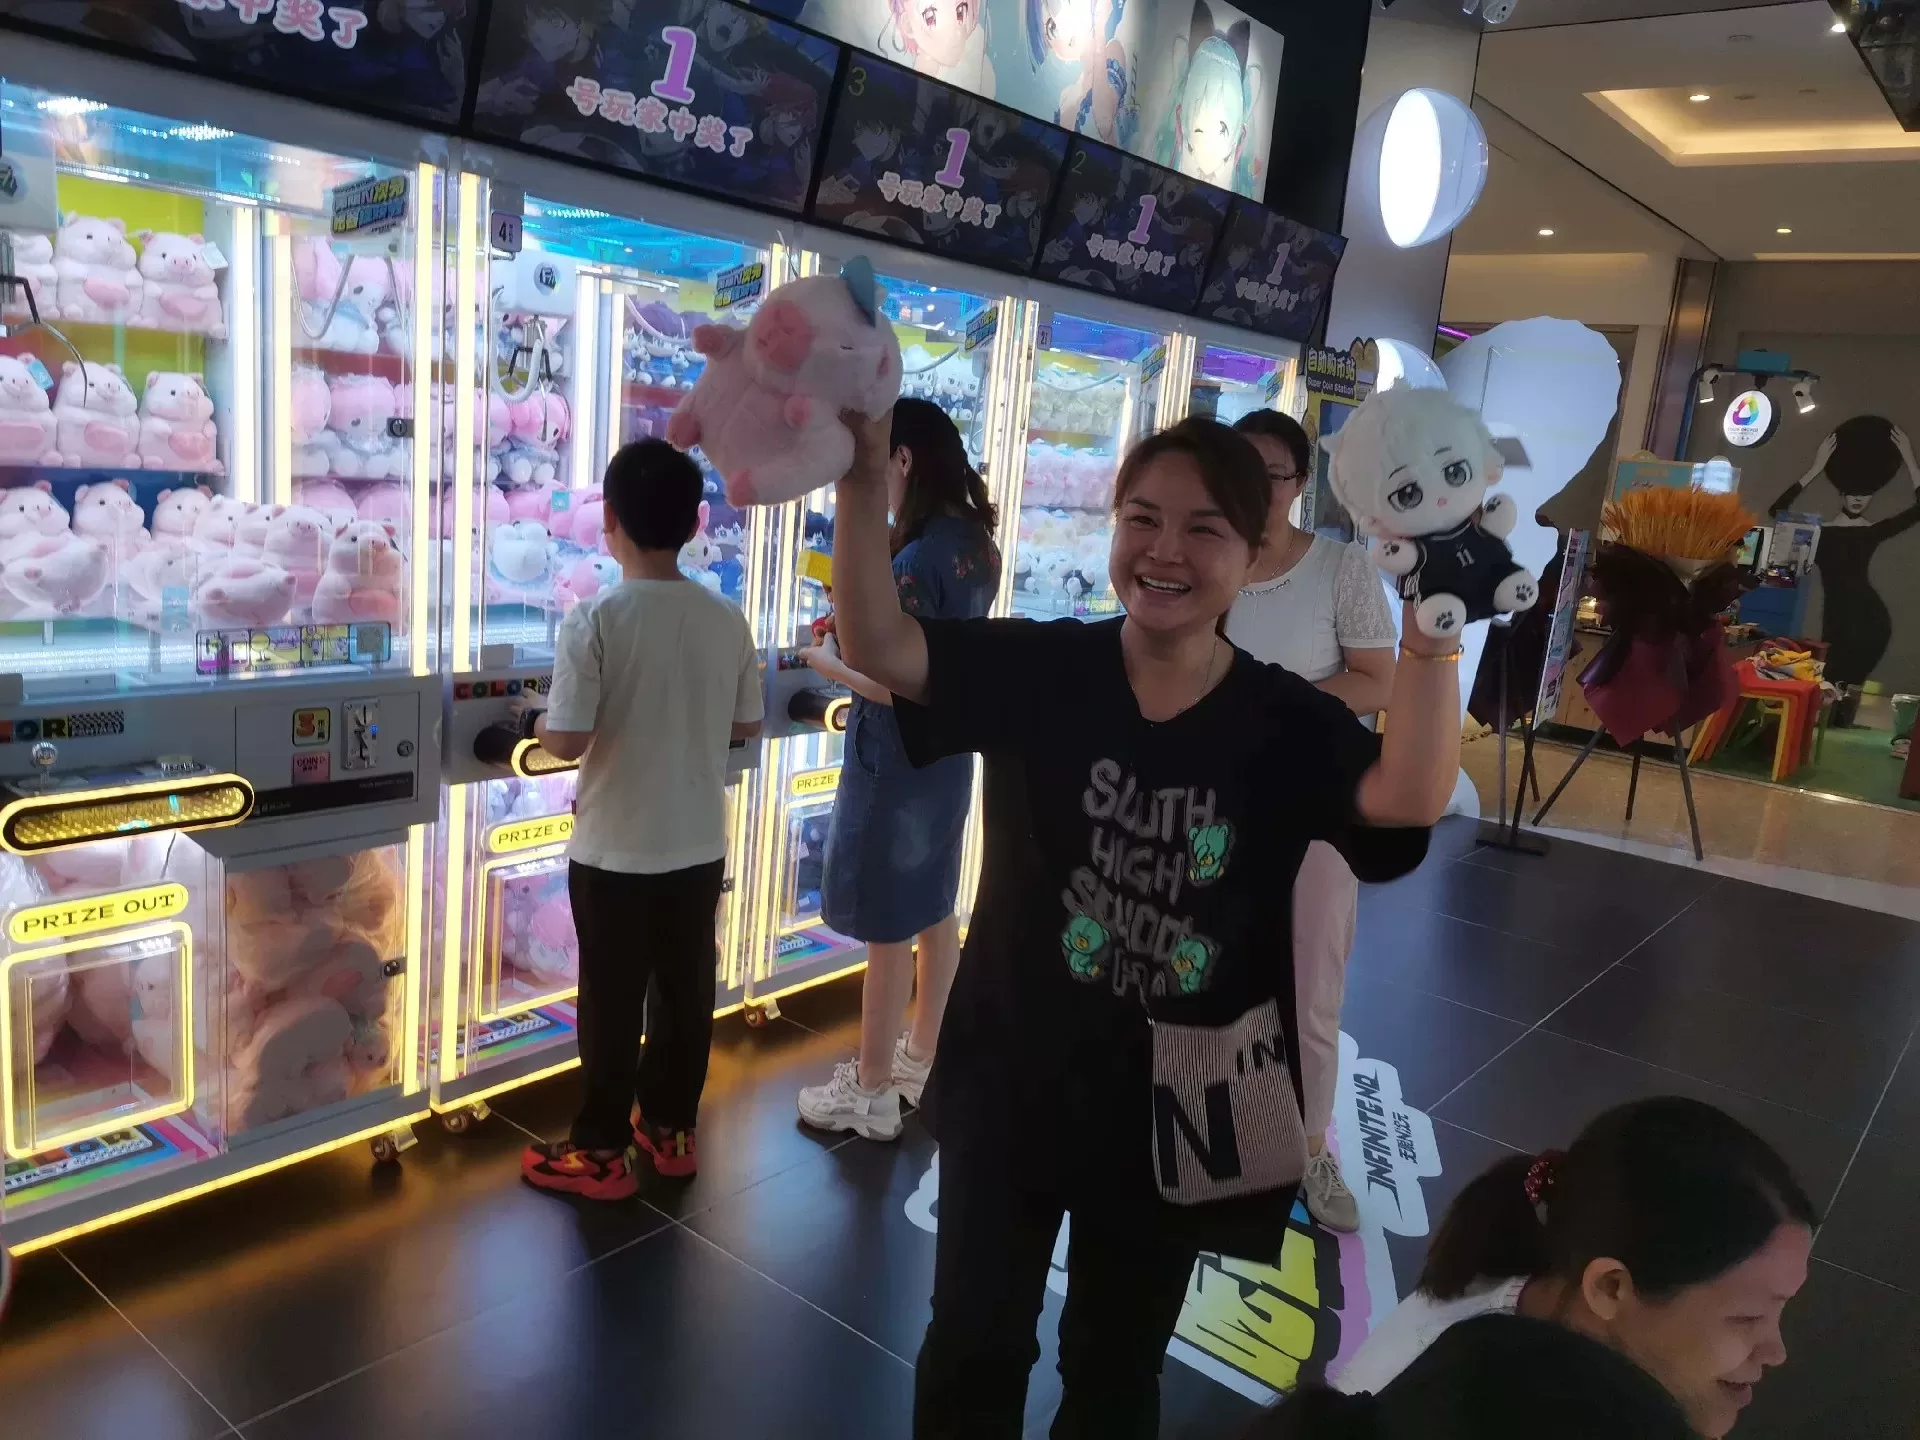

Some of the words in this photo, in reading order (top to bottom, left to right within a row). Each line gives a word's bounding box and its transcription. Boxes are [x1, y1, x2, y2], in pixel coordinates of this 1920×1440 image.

[180, 0, 368, 49] 中奖了
[651, 26, 697, 104] 1
[848, 67, 867, 96] 3
[566, 76, 754, 157] 号玩家中奖了
[935, 128, 970, 189] 1
[1071, 150, 1087, 175] 2
[877, 171, 1002, 228] 号玩家中奖了
[1127, 194, 1157, 244] 1
[1266, 242, 1291, 286] 1
[1307, 347, 1356, 381] 自助购币站
[1307, 376, 1322, 388] Super
[1322, 380, 1334, 390] Coin
[1334, 383, 1354, 396] Station
[296, 711, 316, 737] 3
[796, 774, 834, 790] PRIZE
[498, 824, 553, 845] PRIZE
[1090, 826, 1186, 904] HIGH
[23, 903, 115, 933] PRIZE
[123, 893, 175, 914] OUT
[1153, 1080, 1243, 1188] N
